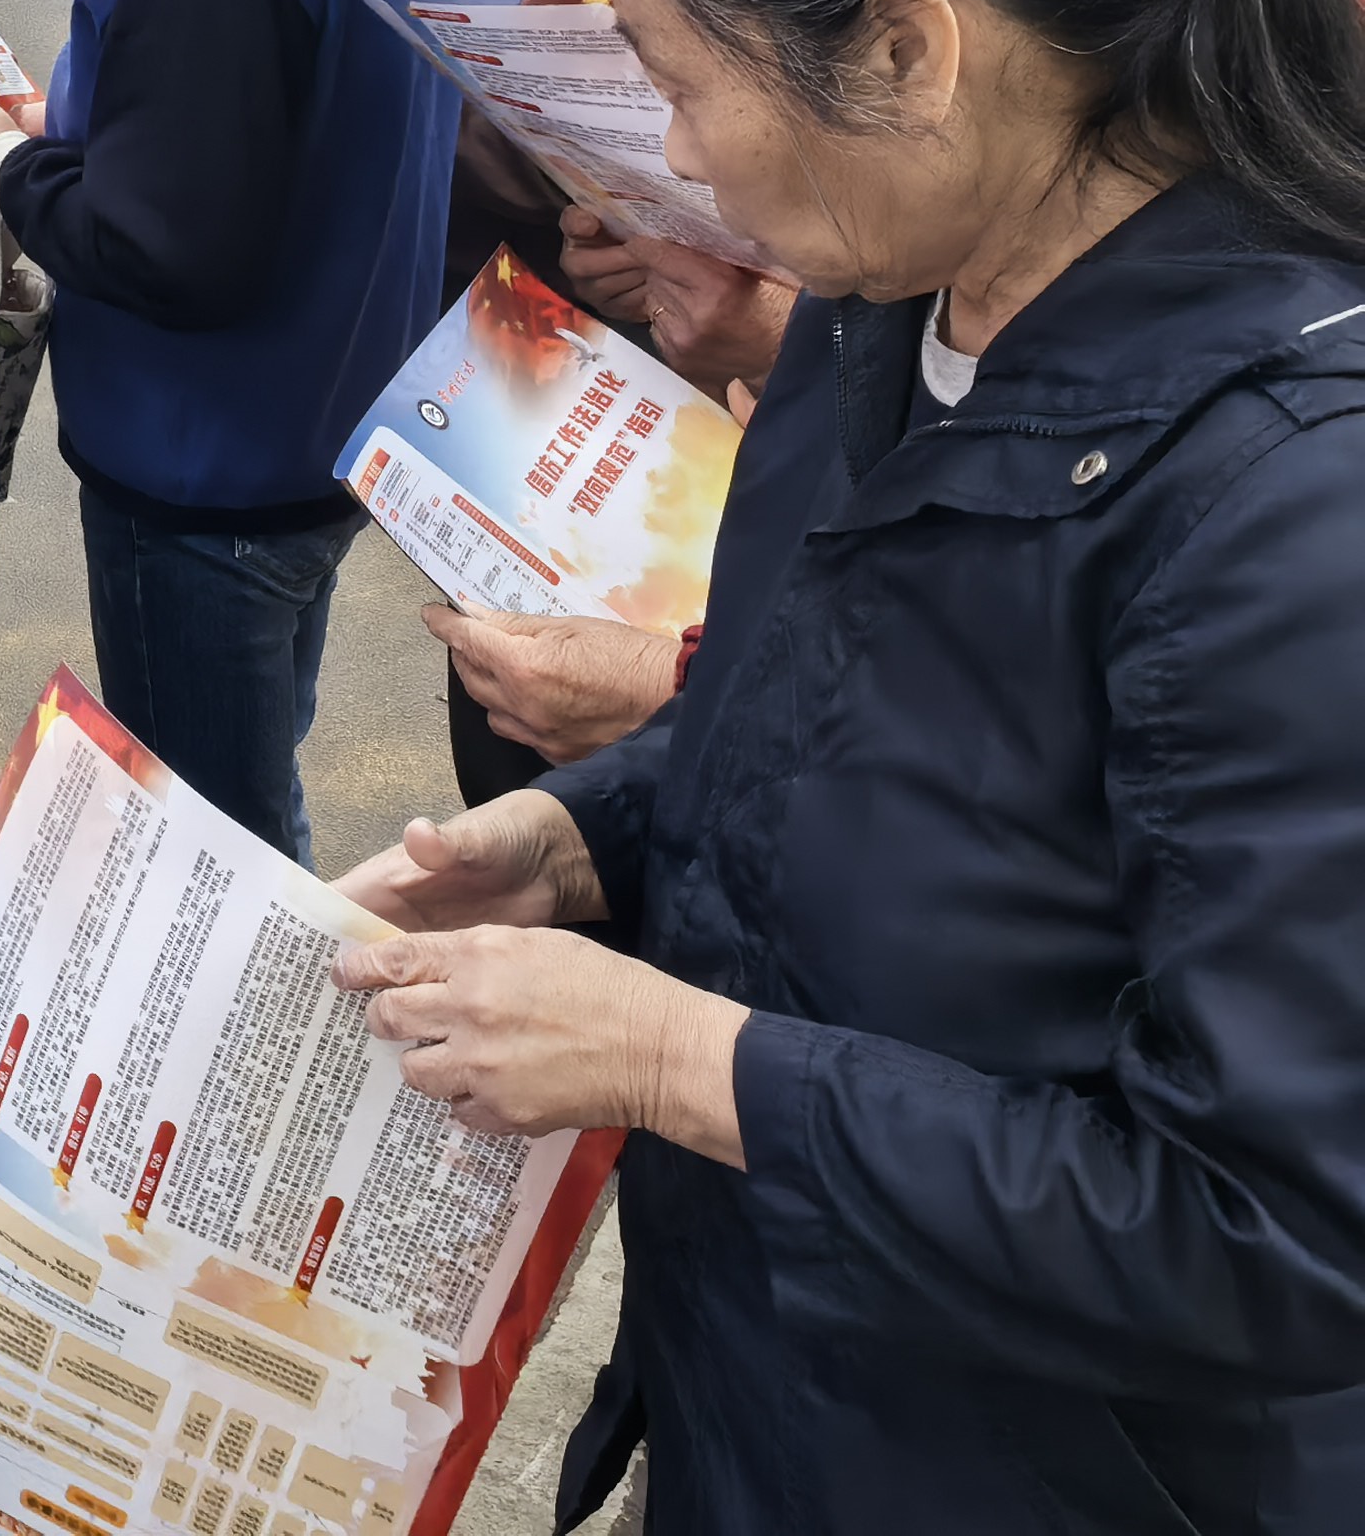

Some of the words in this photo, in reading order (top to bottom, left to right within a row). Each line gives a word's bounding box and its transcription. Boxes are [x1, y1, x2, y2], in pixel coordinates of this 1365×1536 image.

[524, 368, 629, 499] 信访工作法治化
